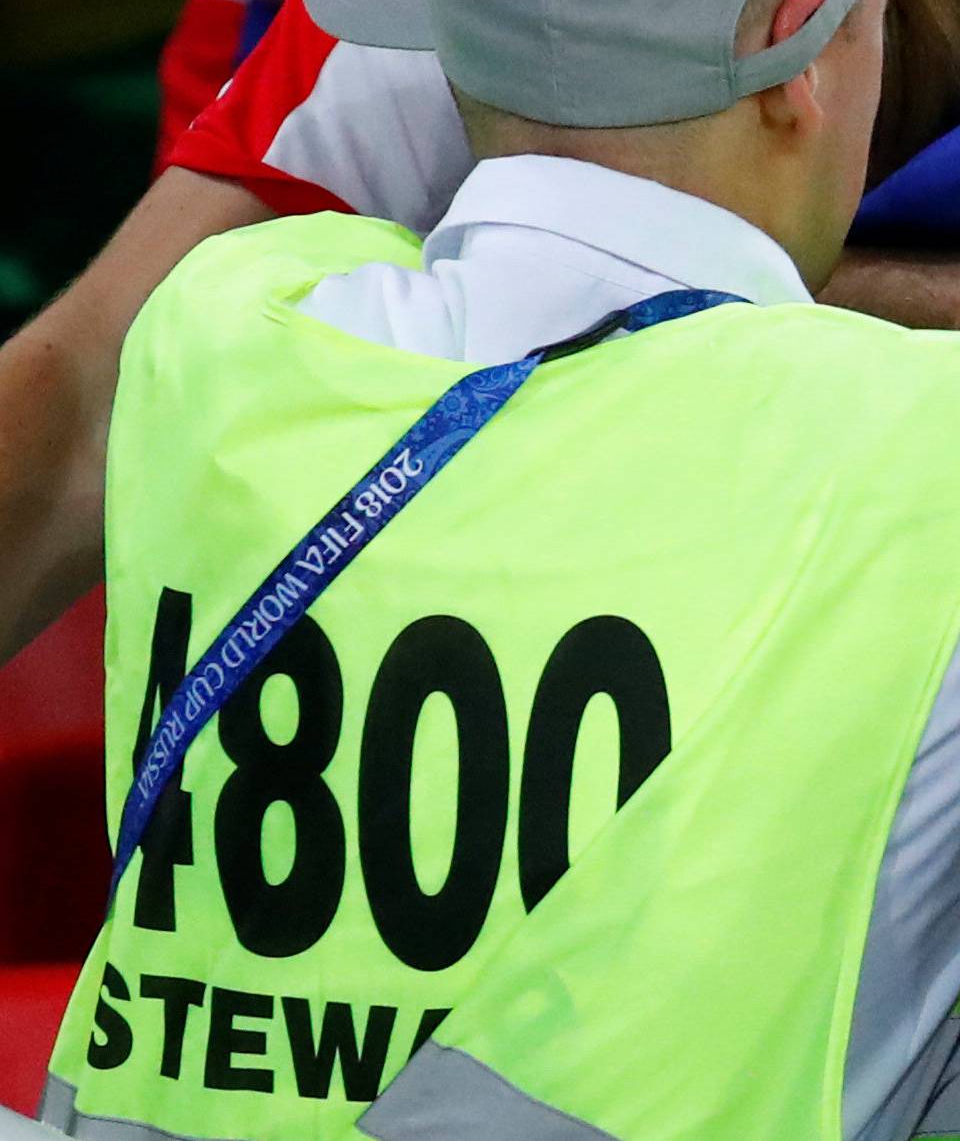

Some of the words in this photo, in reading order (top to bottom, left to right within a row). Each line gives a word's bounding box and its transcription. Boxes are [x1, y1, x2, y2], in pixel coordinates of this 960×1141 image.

[354, 447, 424, 518] 2018
[295, 511, 365, 576] FIFA
[220, 572, 309, 668] WORLD
[184, 661, 225, 722] CUP
[132, 586, 671, 972] 4800
[137, 710, 186, 800] RUSSIA
